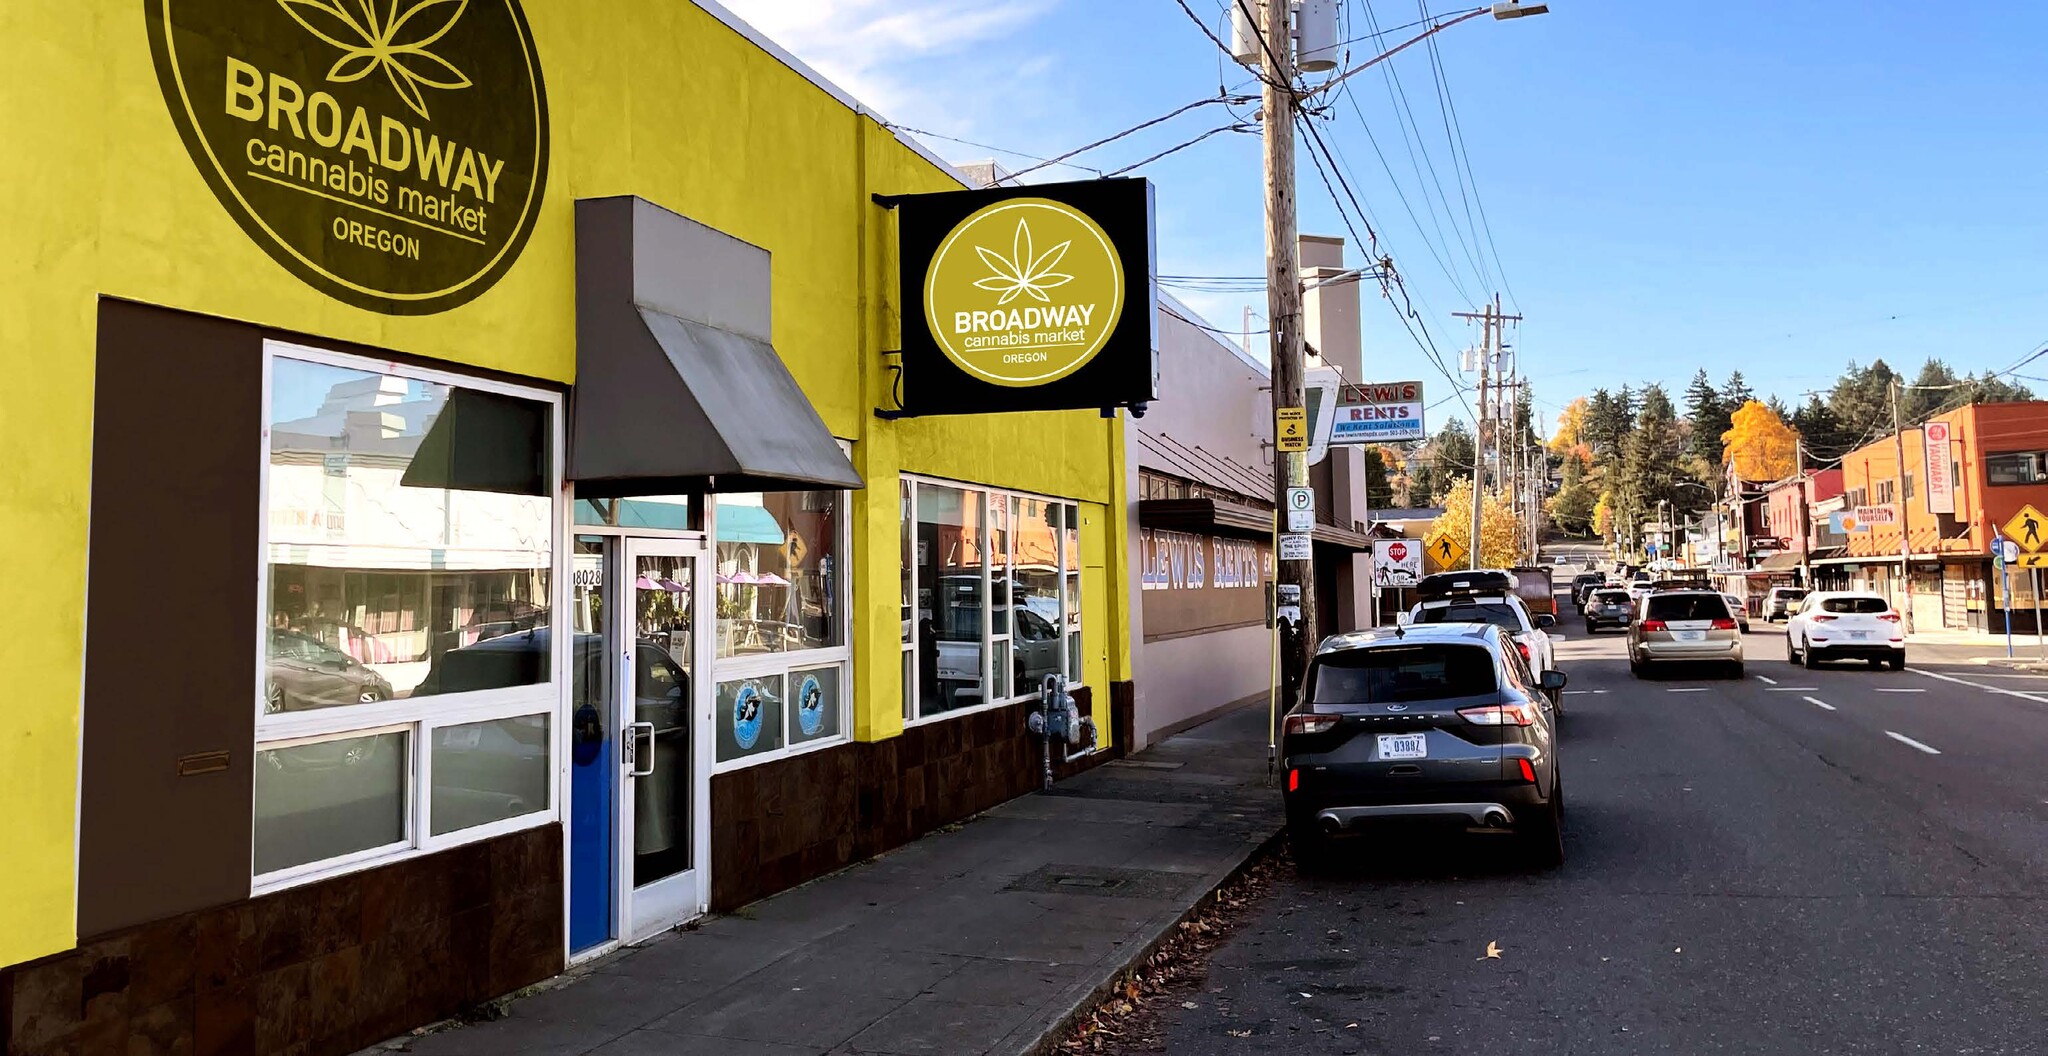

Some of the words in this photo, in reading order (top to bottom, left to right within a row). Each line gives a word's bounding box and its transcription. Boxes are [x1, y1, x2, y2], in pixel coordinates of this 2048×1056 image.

[225, 55, 505, 204] BROADWAY
[246, 138, 389, 205] cannabis
[398, 184, 487, 236] market
[333, 216, 420, 260] OREGON
[955, 303, 1095, 334] BROADWAY
[964, 331, 1030, 347] cannabis
[1034, 328, 1085, 344] market
[1003, 352, 1047, 364] OREGON
[1345, 383, 1416, 403] LEWIS
[1350, 406, 1409, 421] RENTS
[1928, 443, 1943, 495] YAOWARAT
[1857, 507, 1888, 515] MAINTAIN
[1858, 514, 1888, 522] YOURSELF
[1140, 527, 1204, 590] LEWIS
[1212, 536, 1258, 589] RENTS
[1389, 547, 1407, 556] STOP
[1401, 561, 1418, 569] HERE
